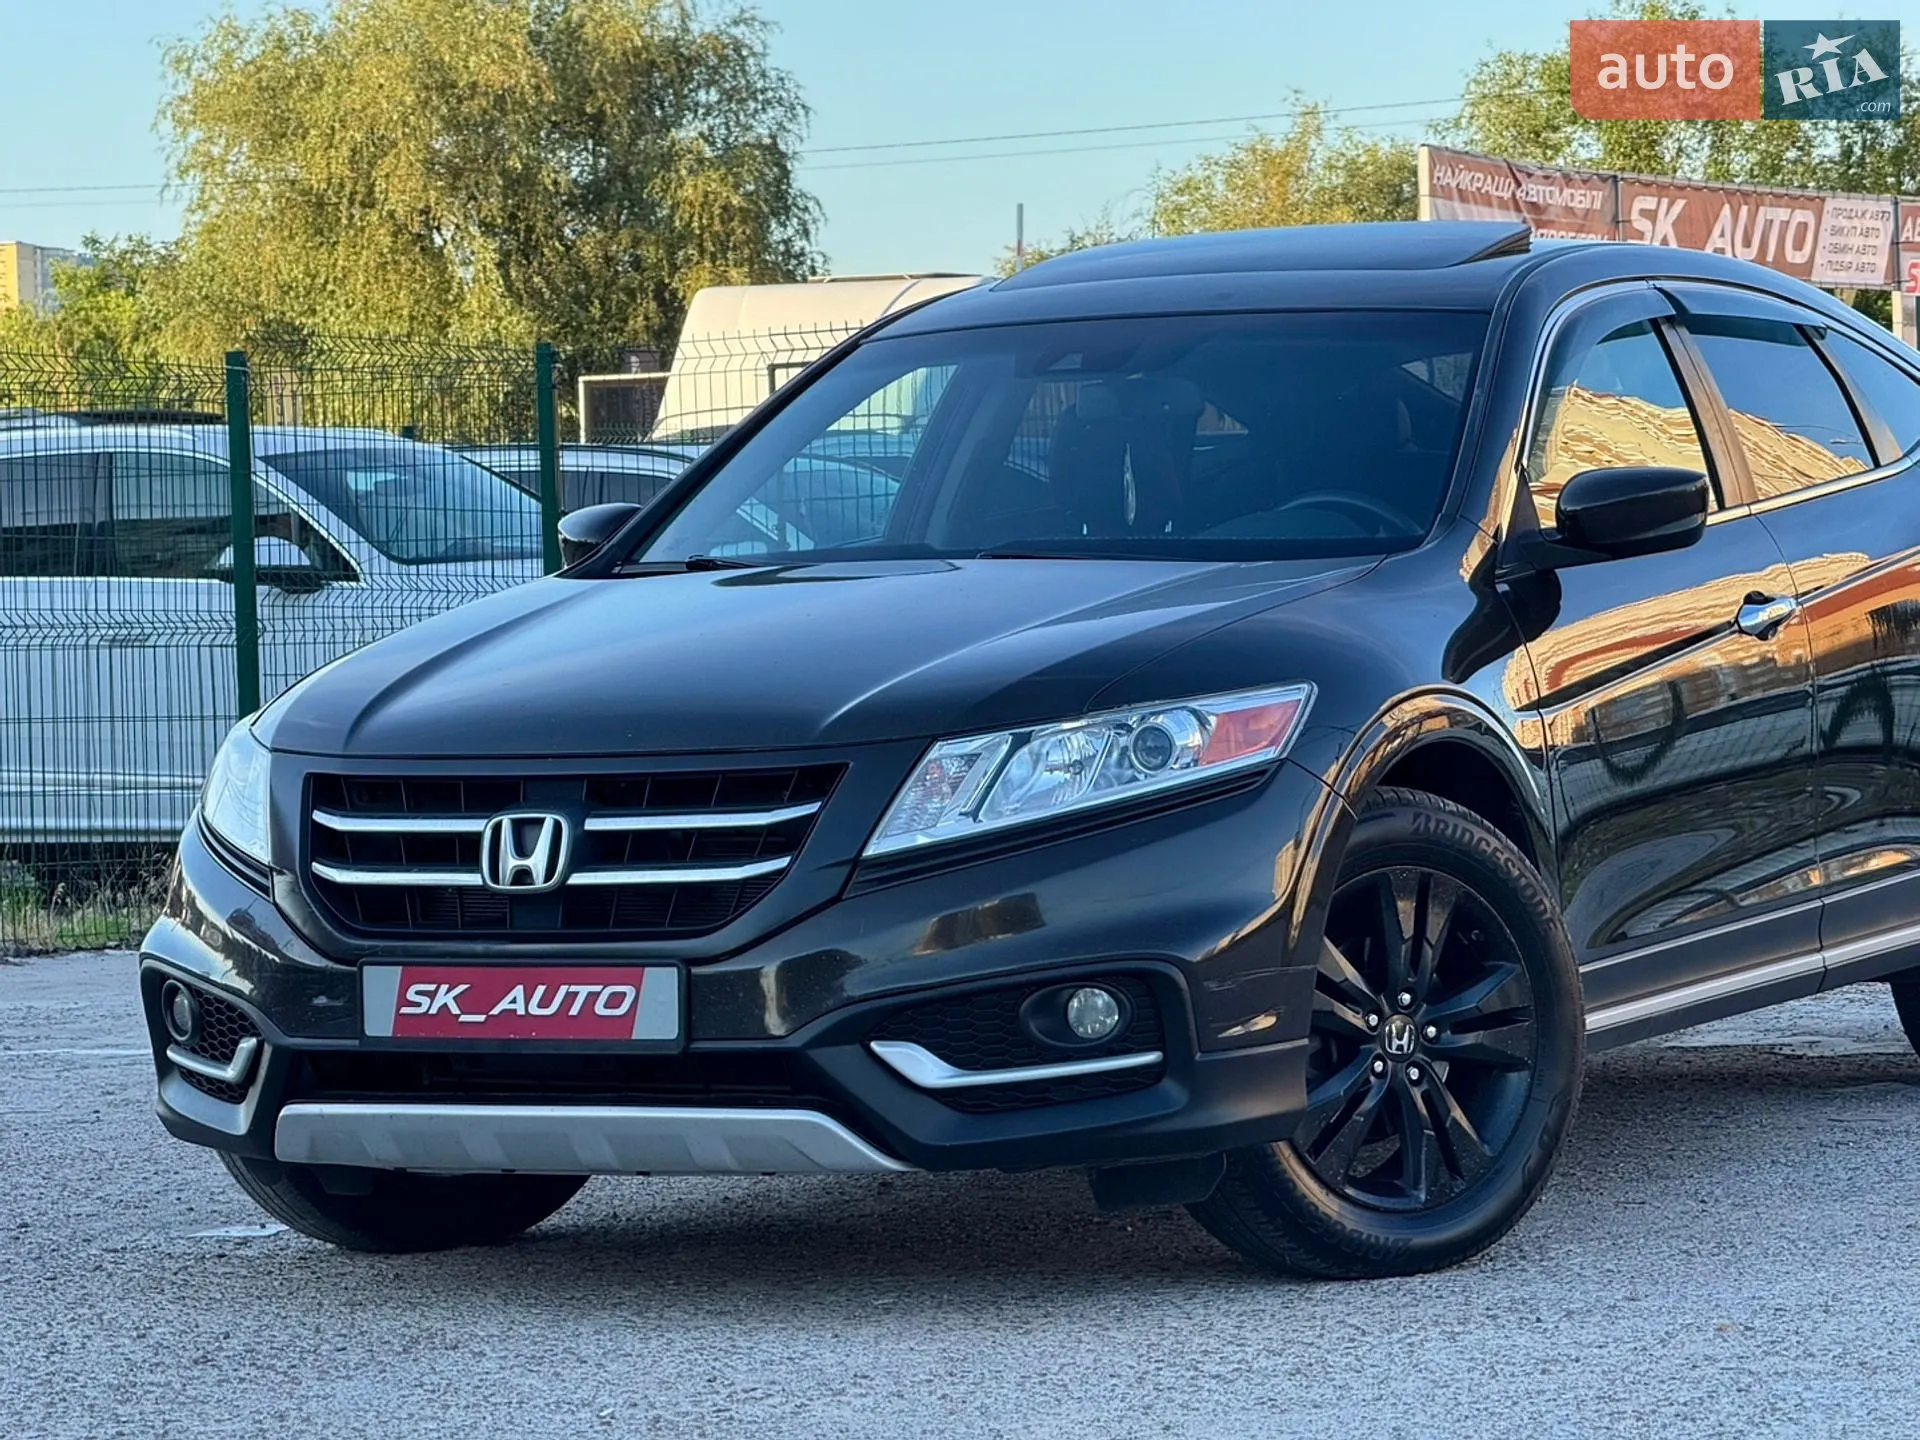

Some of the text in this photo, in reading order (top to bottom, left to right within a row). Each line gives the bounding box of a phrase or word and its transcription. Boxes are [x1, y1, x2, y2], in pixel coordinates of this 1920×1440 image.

[1516, 182, 1604, 210] АВТОМОБІЛІ
[1869, 209, 1891, 222] АВТО
[1628, 195, 1816, 264] SK AUTO
[1858, 226, 1880, 239] АВТО
[1855, 244, 1877, 256] АВТО
[1854, 262, 1876, 273] АВТО
[399, 983, 637, 1023] SK_AUTO
